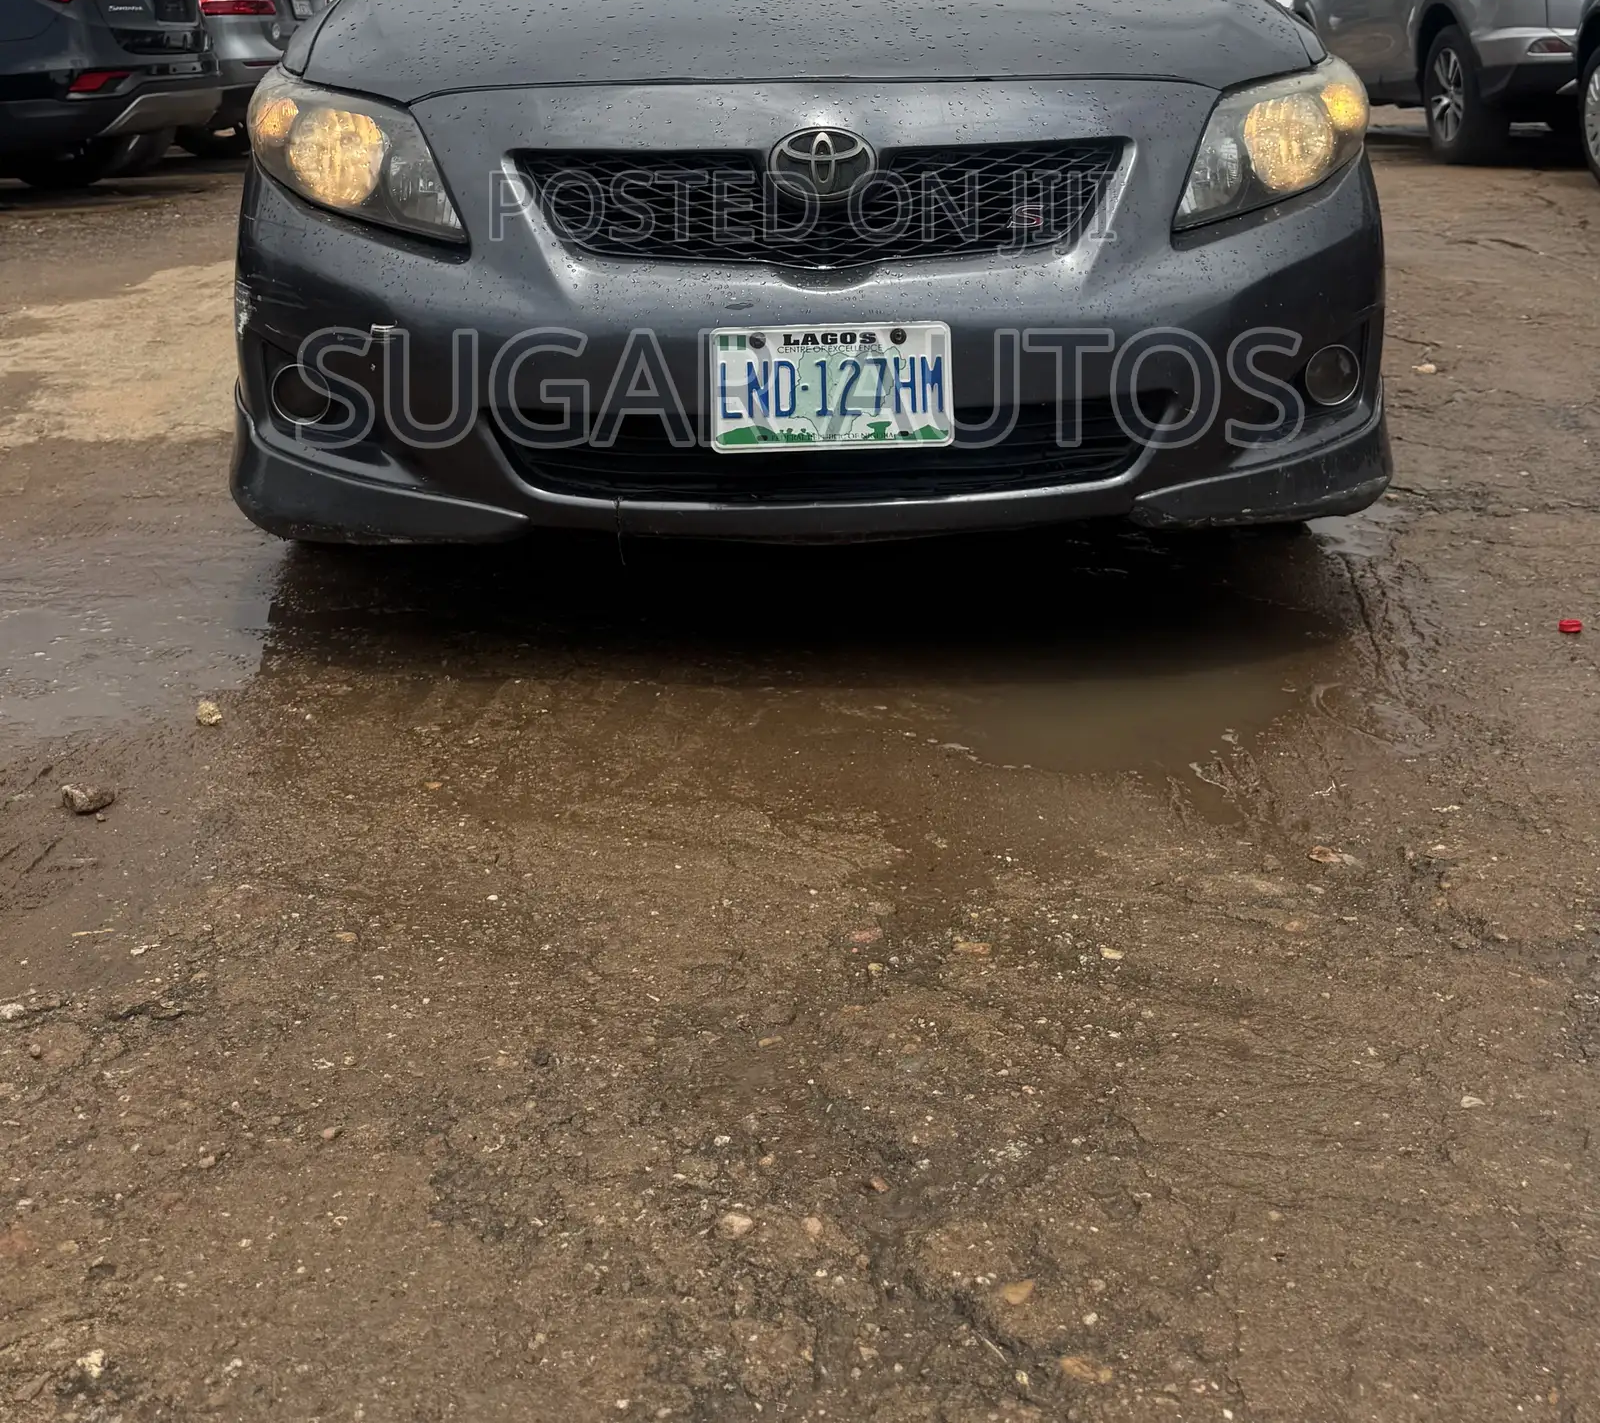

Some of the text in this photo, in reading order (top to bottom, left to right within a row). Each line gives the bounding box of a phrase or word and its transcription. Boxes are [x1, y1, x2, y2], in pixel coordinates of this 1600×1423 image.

[783, 332, 877, 346] LAGOS
[776, 343, 884, 354] CENTRE OF EXCELLENCE
